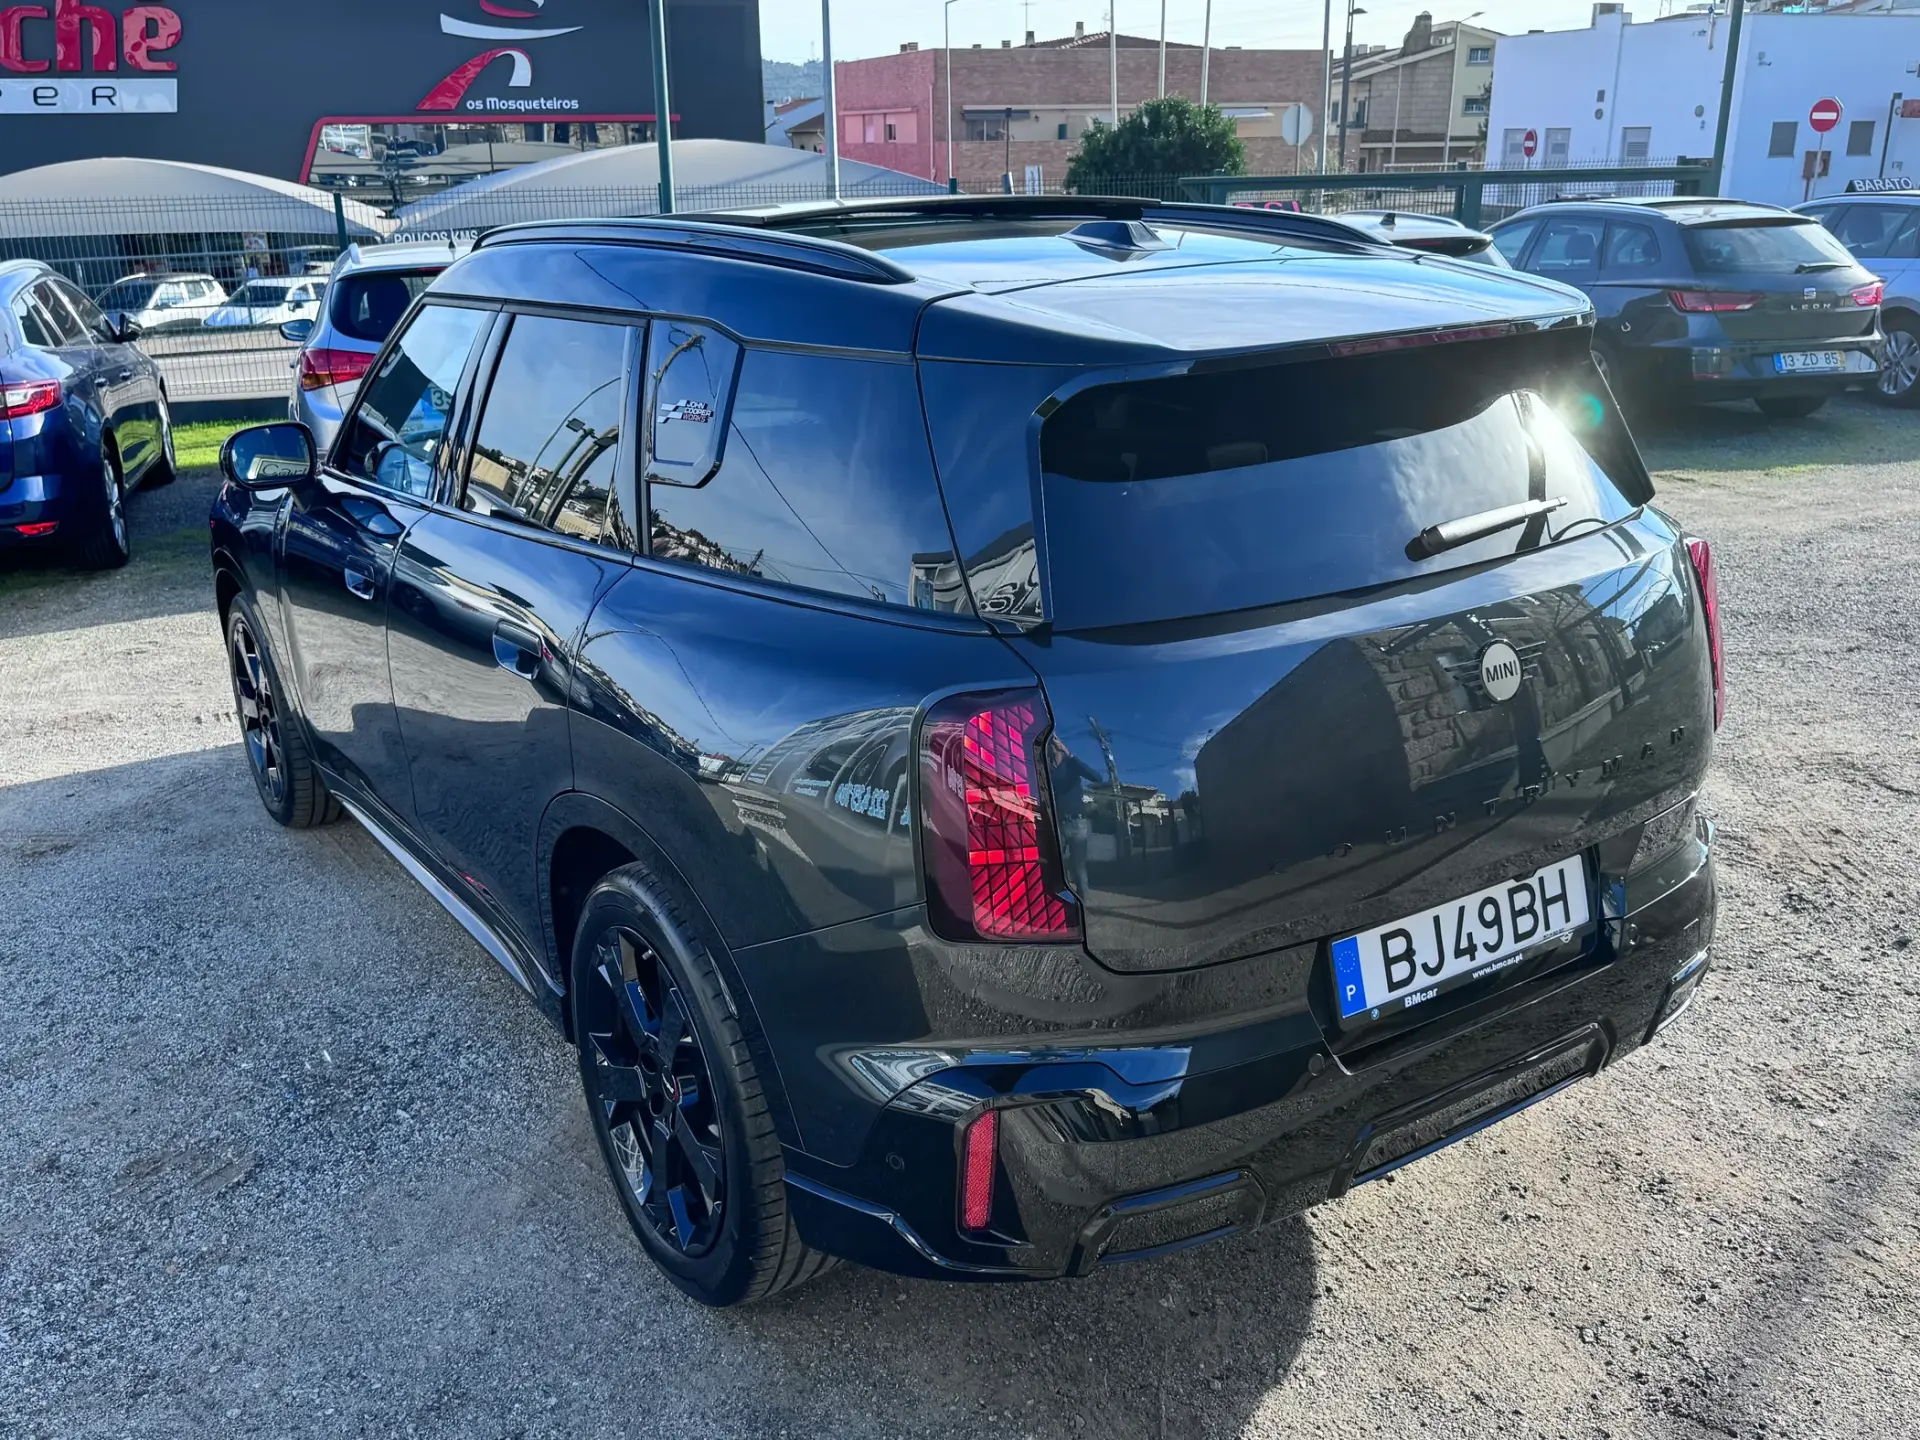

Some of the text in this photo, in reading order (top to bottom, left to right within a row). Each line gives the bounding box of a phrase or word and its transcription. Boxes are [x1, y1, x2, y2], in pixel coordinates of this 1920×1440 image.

[466, 97, 579, 112] os Mosqueteiros
[1853, 177, 1912, 192] BARATO
[1790, 303, 1831, 311] LEON
[684, 407, 712, 416] COOPER
[686, 401, 706, 409] JOHN
[682, 413, 706, 423] WORKS
[1485, 659, 1518, 683] MINI
[1379, 867, 1571, 994] BJ49BH
[1472, 953, 1523, 979] www.bmcar.pt
[1346, 984, 1356, 1002] P
[1404, 988, 1438, 1008] BMcar
